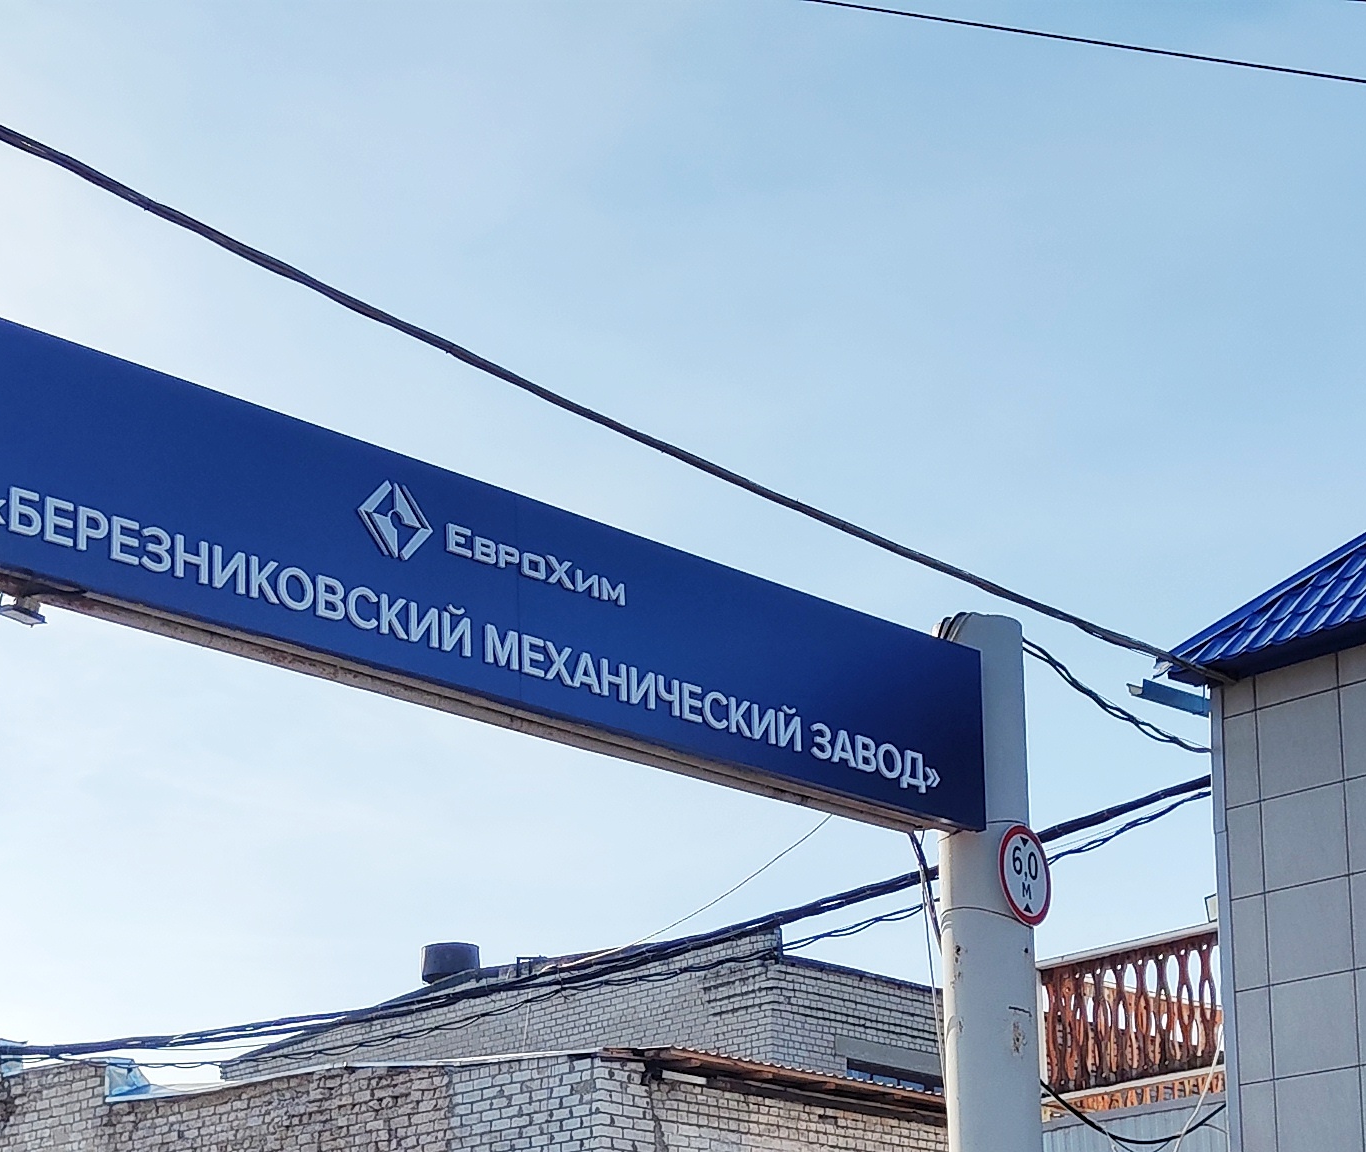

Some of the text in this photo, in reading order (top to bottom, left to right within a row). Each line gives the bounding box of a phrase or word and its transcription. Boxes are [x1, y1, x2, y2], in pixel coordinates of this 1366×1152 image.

[484, 623, 802, 752] МЕХАНИЧЕСКИЙ
[810, 722, 941, 794] ЗАВОД»
[1011, 845, 1039, 881] 6,0
